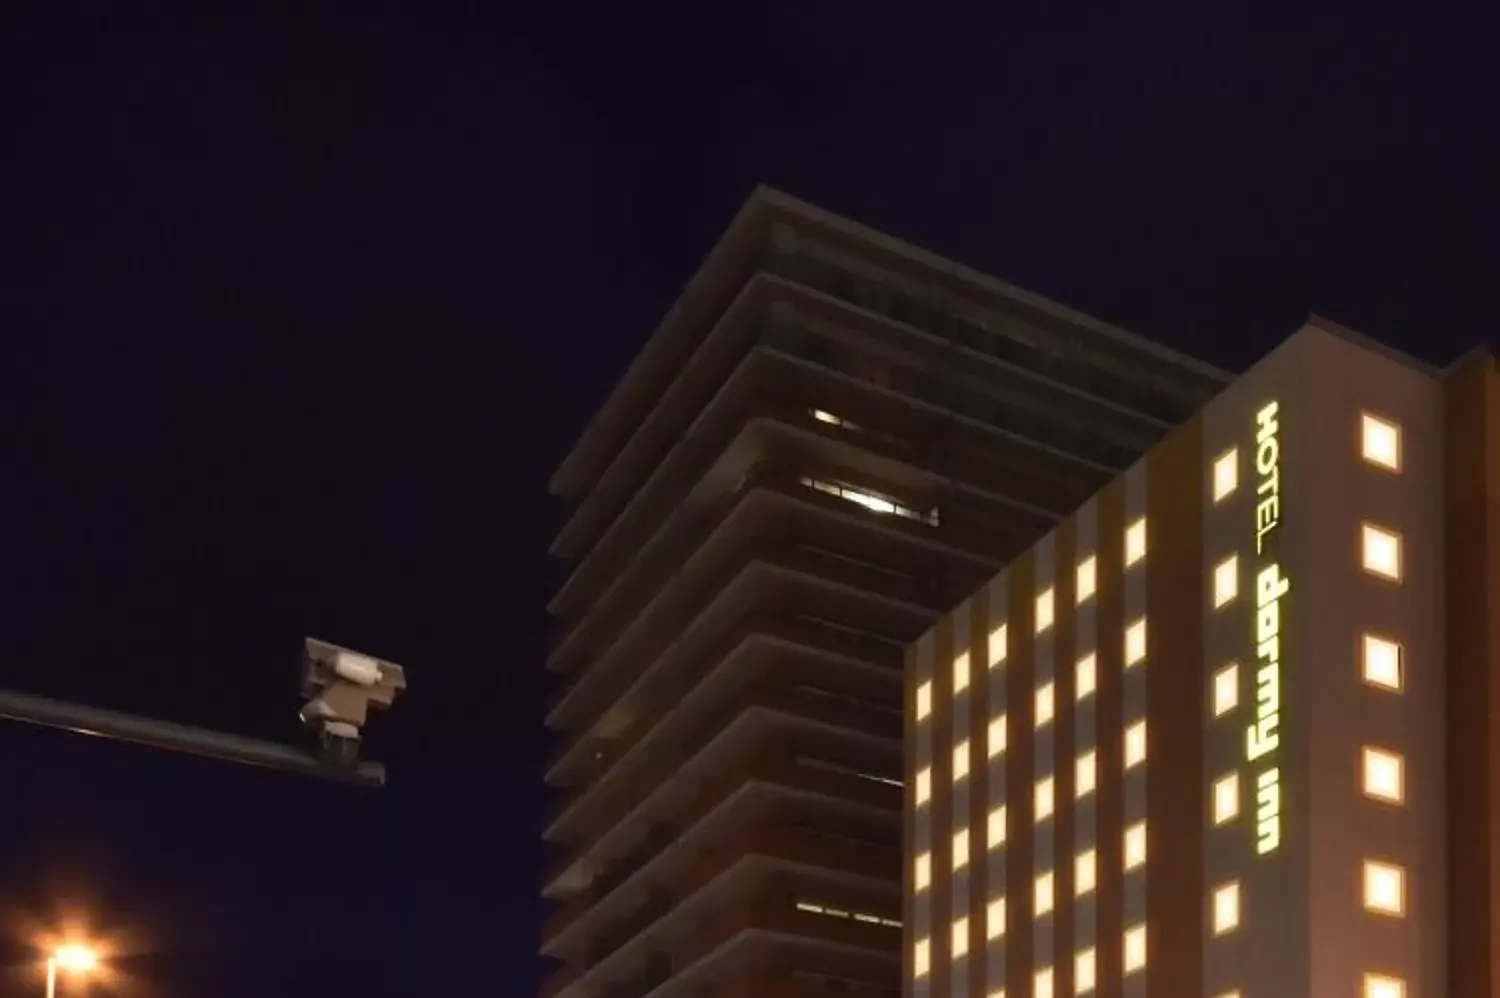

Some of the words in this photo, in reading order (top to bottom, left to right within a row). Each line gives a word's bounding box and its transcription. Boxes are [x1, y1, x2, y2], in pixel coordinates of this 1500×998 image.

[1256, 400, 1279, 556] HOTEL
[1247, 563, 1289, 761] dormy
[1257, 767, 1280, 855] inn
